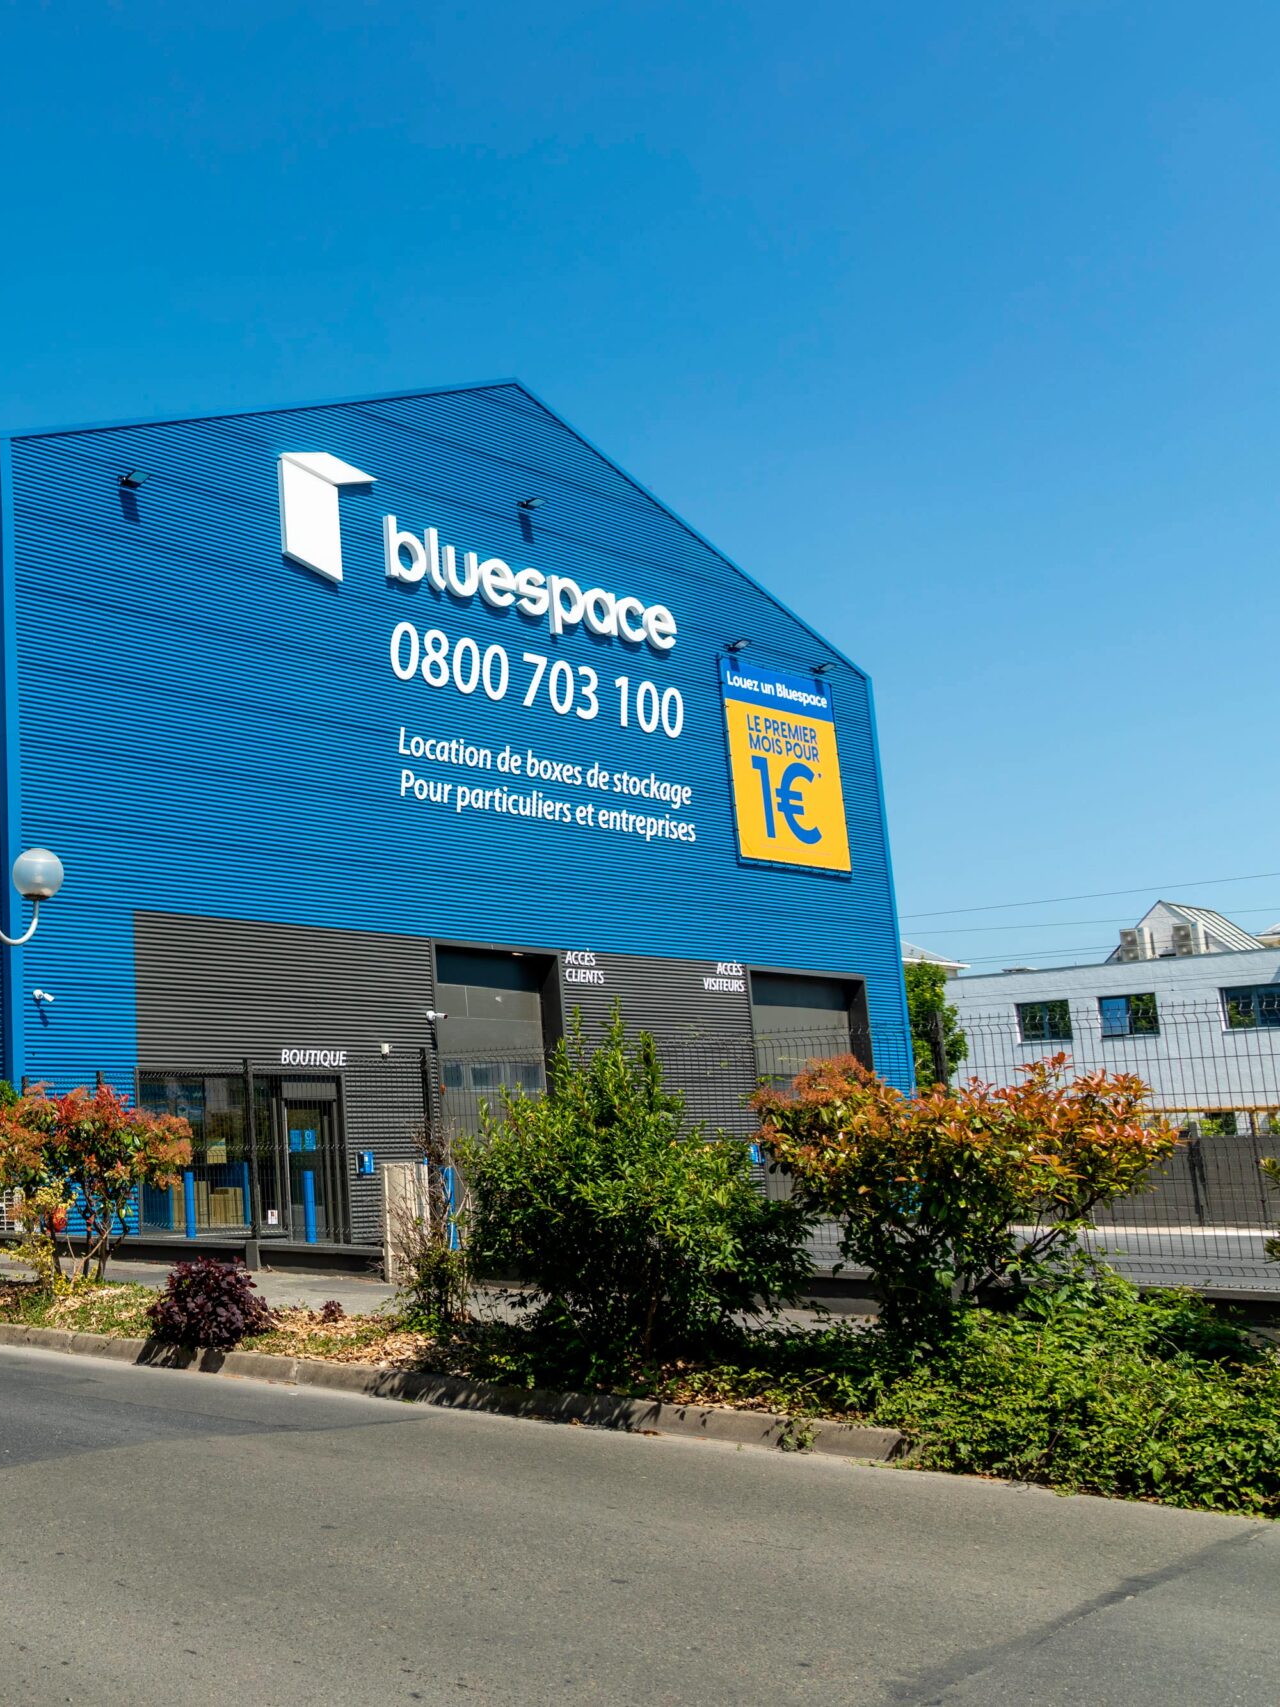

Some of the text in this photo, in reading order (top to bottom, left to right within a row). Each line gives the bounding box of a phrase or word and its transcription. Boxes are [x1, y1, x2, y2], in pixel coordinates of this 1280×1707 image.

[383, 515, 677, 650] bluespace
[390, 621, 684, 738] 0800 703 100
[726, 670, 828, 709] Louez un Bluespace
[746, 713, 818, 745] LE PREMIER
[748, 732, 820, 763] MOIS POUR
[398, 726, 692, 810] Location de boxes de stockage
[400, 769, 697, 843] Pour particuliers et entreprises
[564, 948, 596, 966] ACCÈS
[716, 960, 743, 976] ACCÈS
[565, 968, 605, 985] CLIENTS
[702, 977, 745, 993] VISITEURS
[281, 1048, 348, 1068] BOUTIQUE
